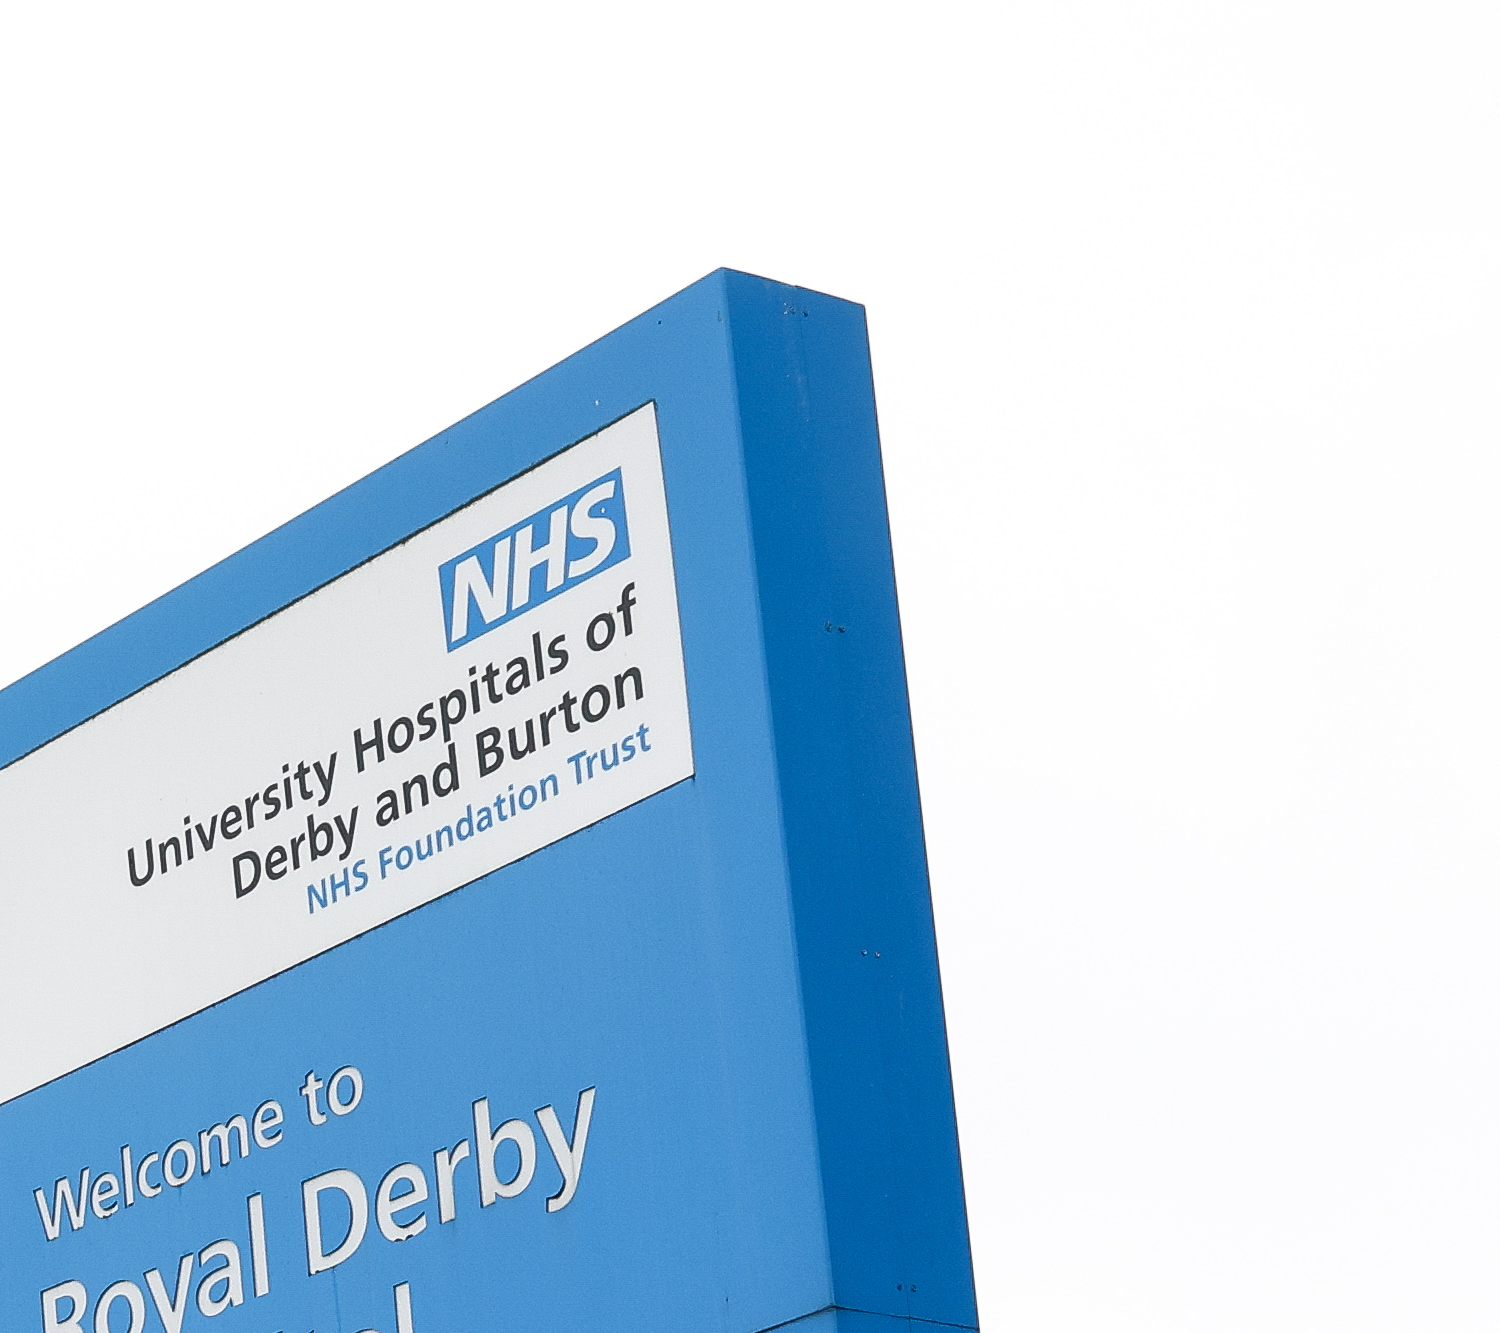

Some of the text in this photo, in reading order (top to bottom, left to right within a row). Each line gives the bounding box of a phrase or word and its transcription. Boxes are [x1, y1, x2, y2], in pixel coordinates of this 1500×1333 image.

[451, 478, 617, 641] NHS
[127, 584, 637, 888] University Hospitals of
[233, 665, 644, 899] Derby and Burton
[307, 725, 652, 914] NHS Foundation Trust
[34, 1064, 365, 1241] Welcome to
[301, 1086, 597, 1276] Derby
